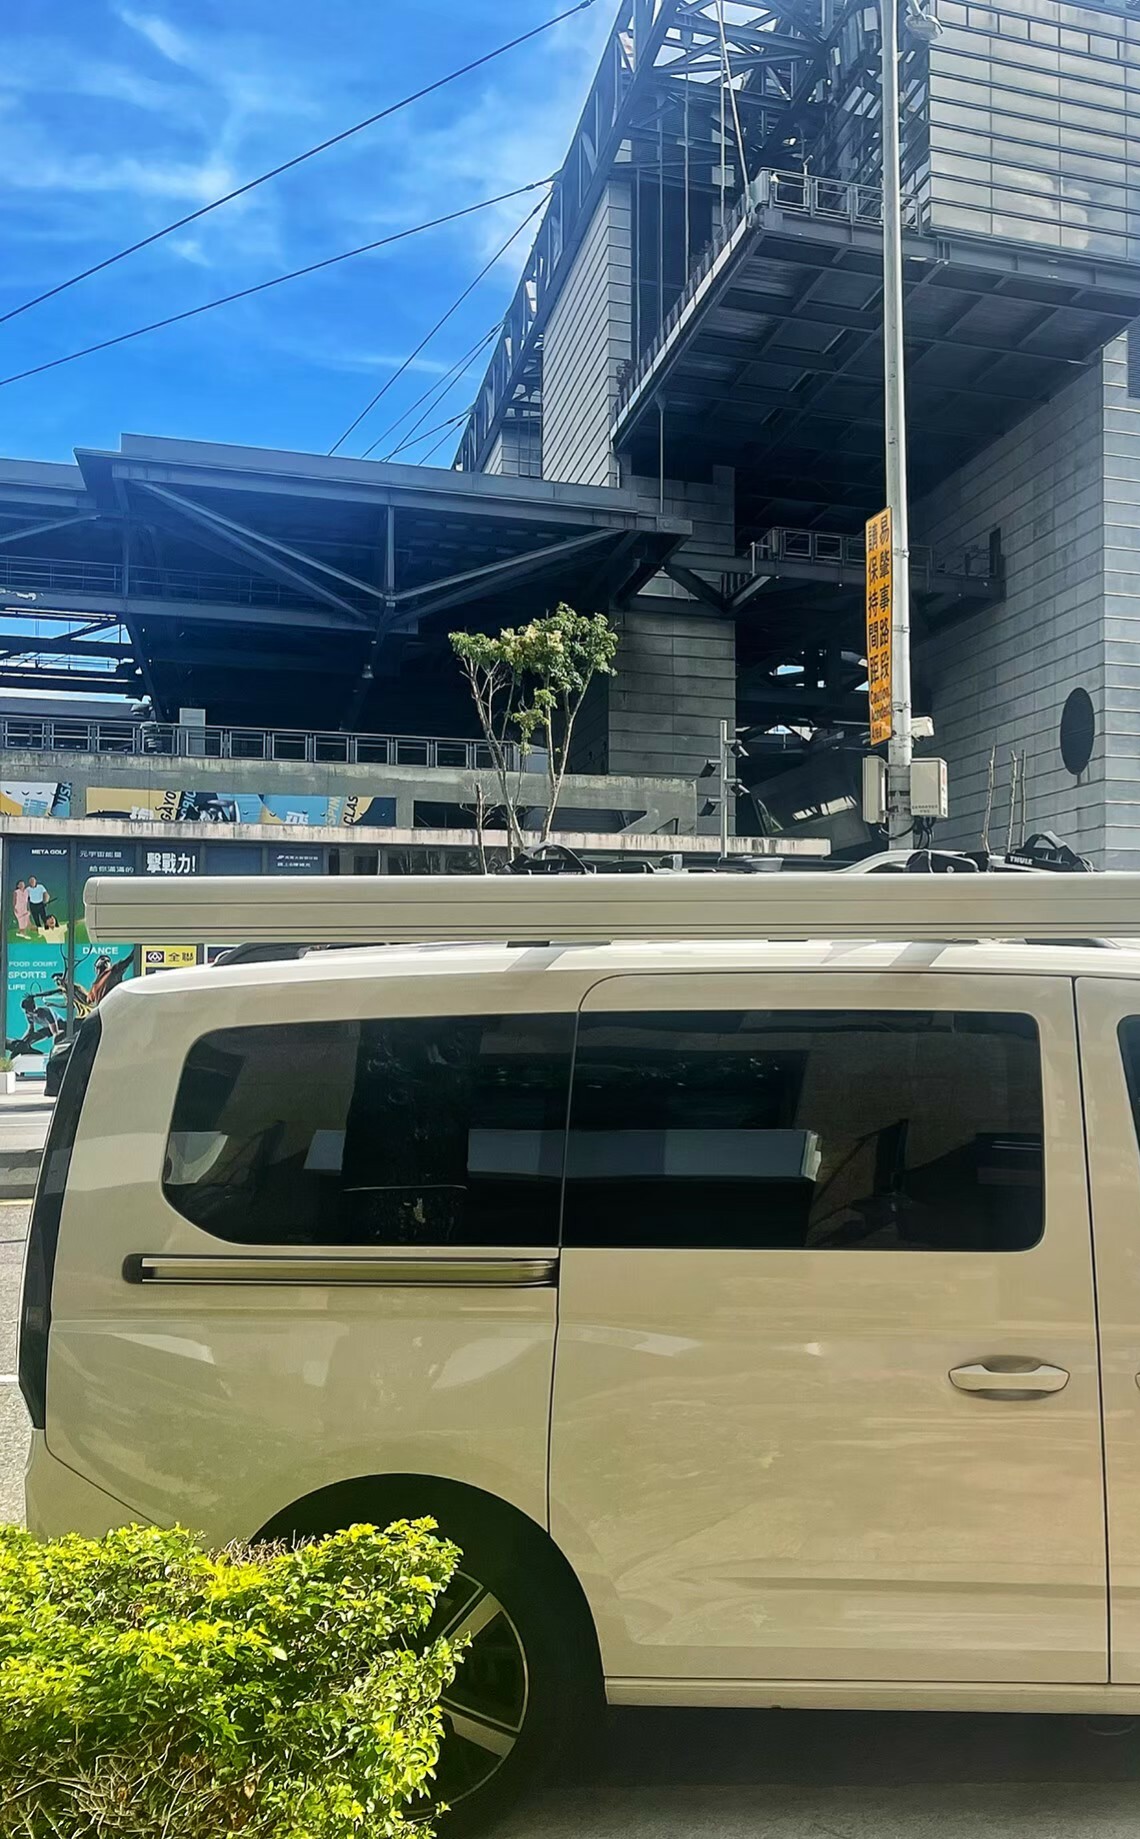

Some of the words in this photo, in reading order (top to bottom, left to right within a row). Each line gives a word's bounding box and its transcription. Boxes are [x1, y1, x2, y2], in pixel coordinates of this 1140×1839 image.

[878, 514, 890, 680] 易肇事路段
[867, 523, 879, 685] 請保持間距
[1009, 856, 1033, 865] THULE
[82, 946, 119, 955] DANCE
[8, 971, 47, 979] SPORTS
